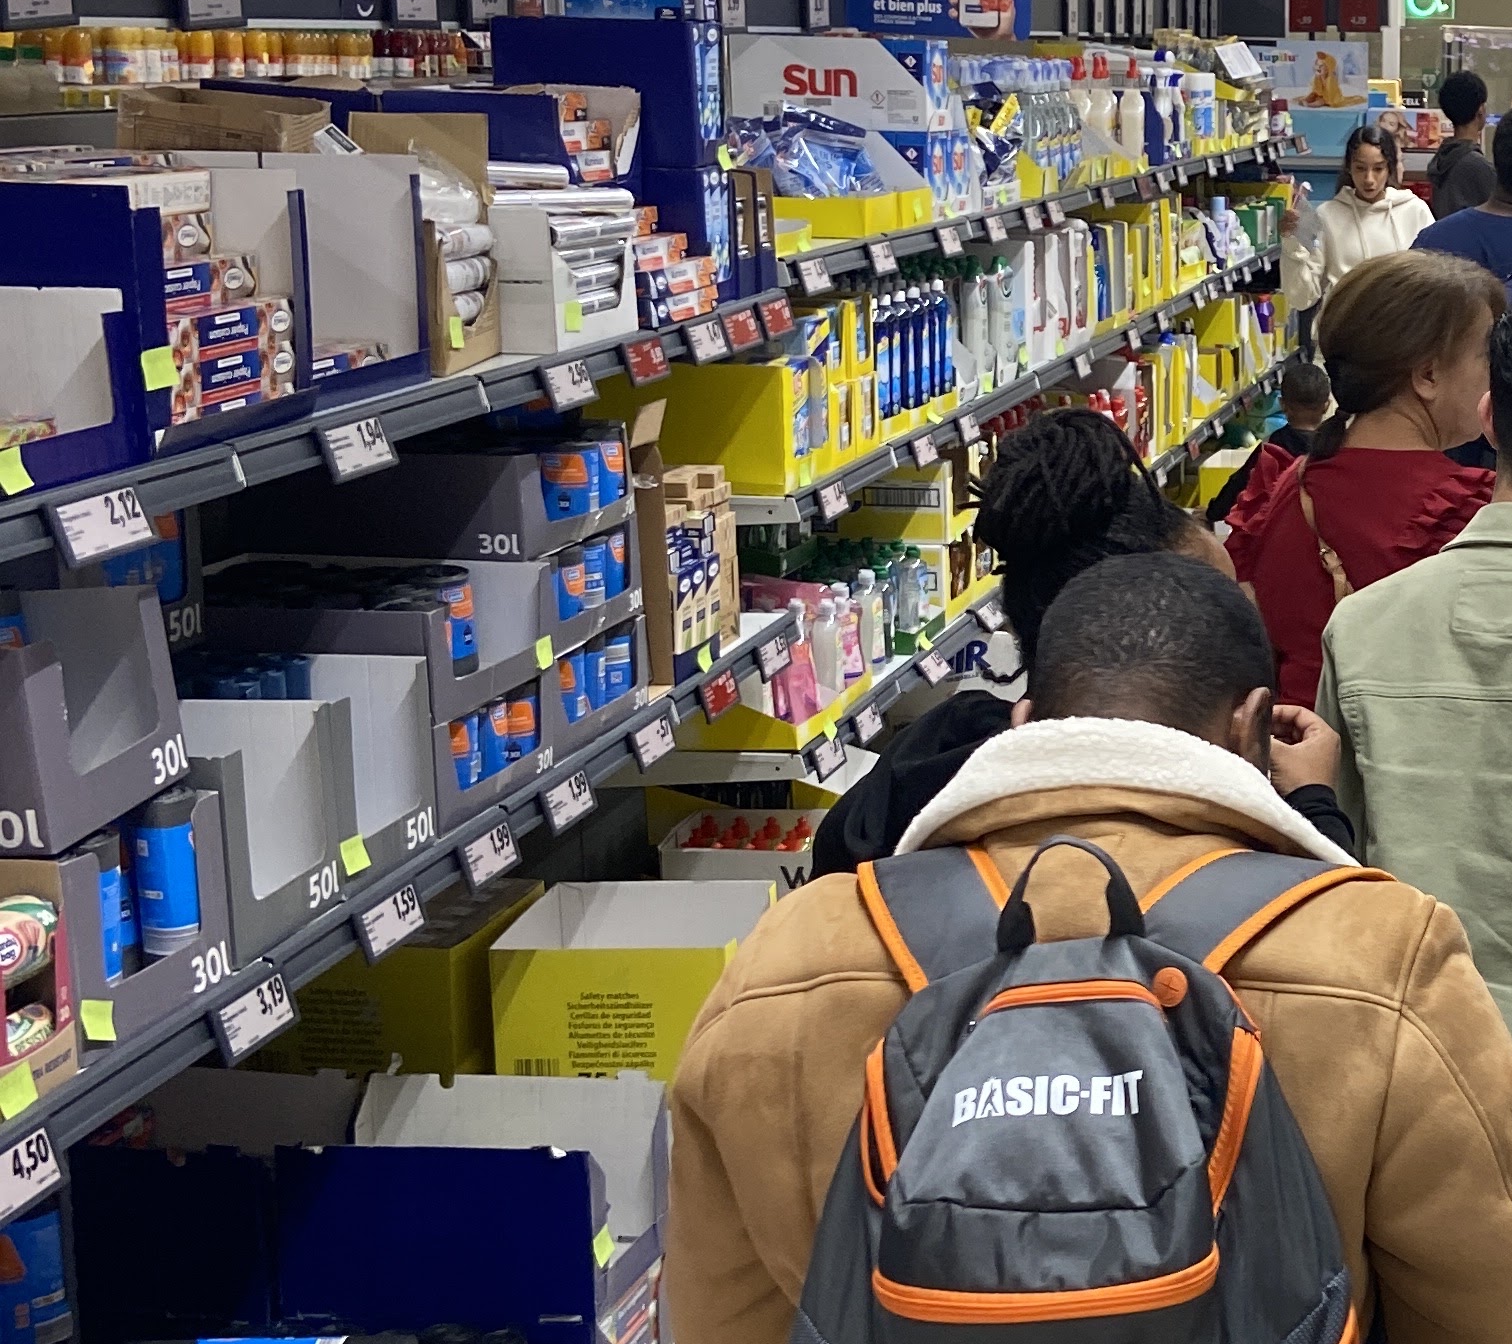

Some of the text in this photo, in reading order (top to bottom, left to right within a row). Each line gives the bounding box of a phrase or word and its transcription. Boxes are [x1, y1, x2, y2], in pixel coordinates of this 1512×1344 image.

[873, 0, 943, 15] et bien plus
[356, 420, 386, 451] 1,94
[103, 489, 141, 528] 2,12
[478, 533, 520, 556] 30l
[169, 603, 202, 642] 50l
[151, 733, 188, 785] 30l
[536, 745, 554, 774] 30l
[568, 773, 587, 801] 1,99
[407, 807, 435, 850] 50l
[490, 823, 511, 859] 1,99
[309, 861, 340, 908] 50l
[392, 887, 417, 922] 1,59
[191, 940, 231, 993] 30l
[256, 976, 285, 1016] 3,19
[580, 992, 605, 1001] Safety
[951, 1069, 1144, 1128] BASIC-FIT
[12, 1133, 50, 1180] 4,50
